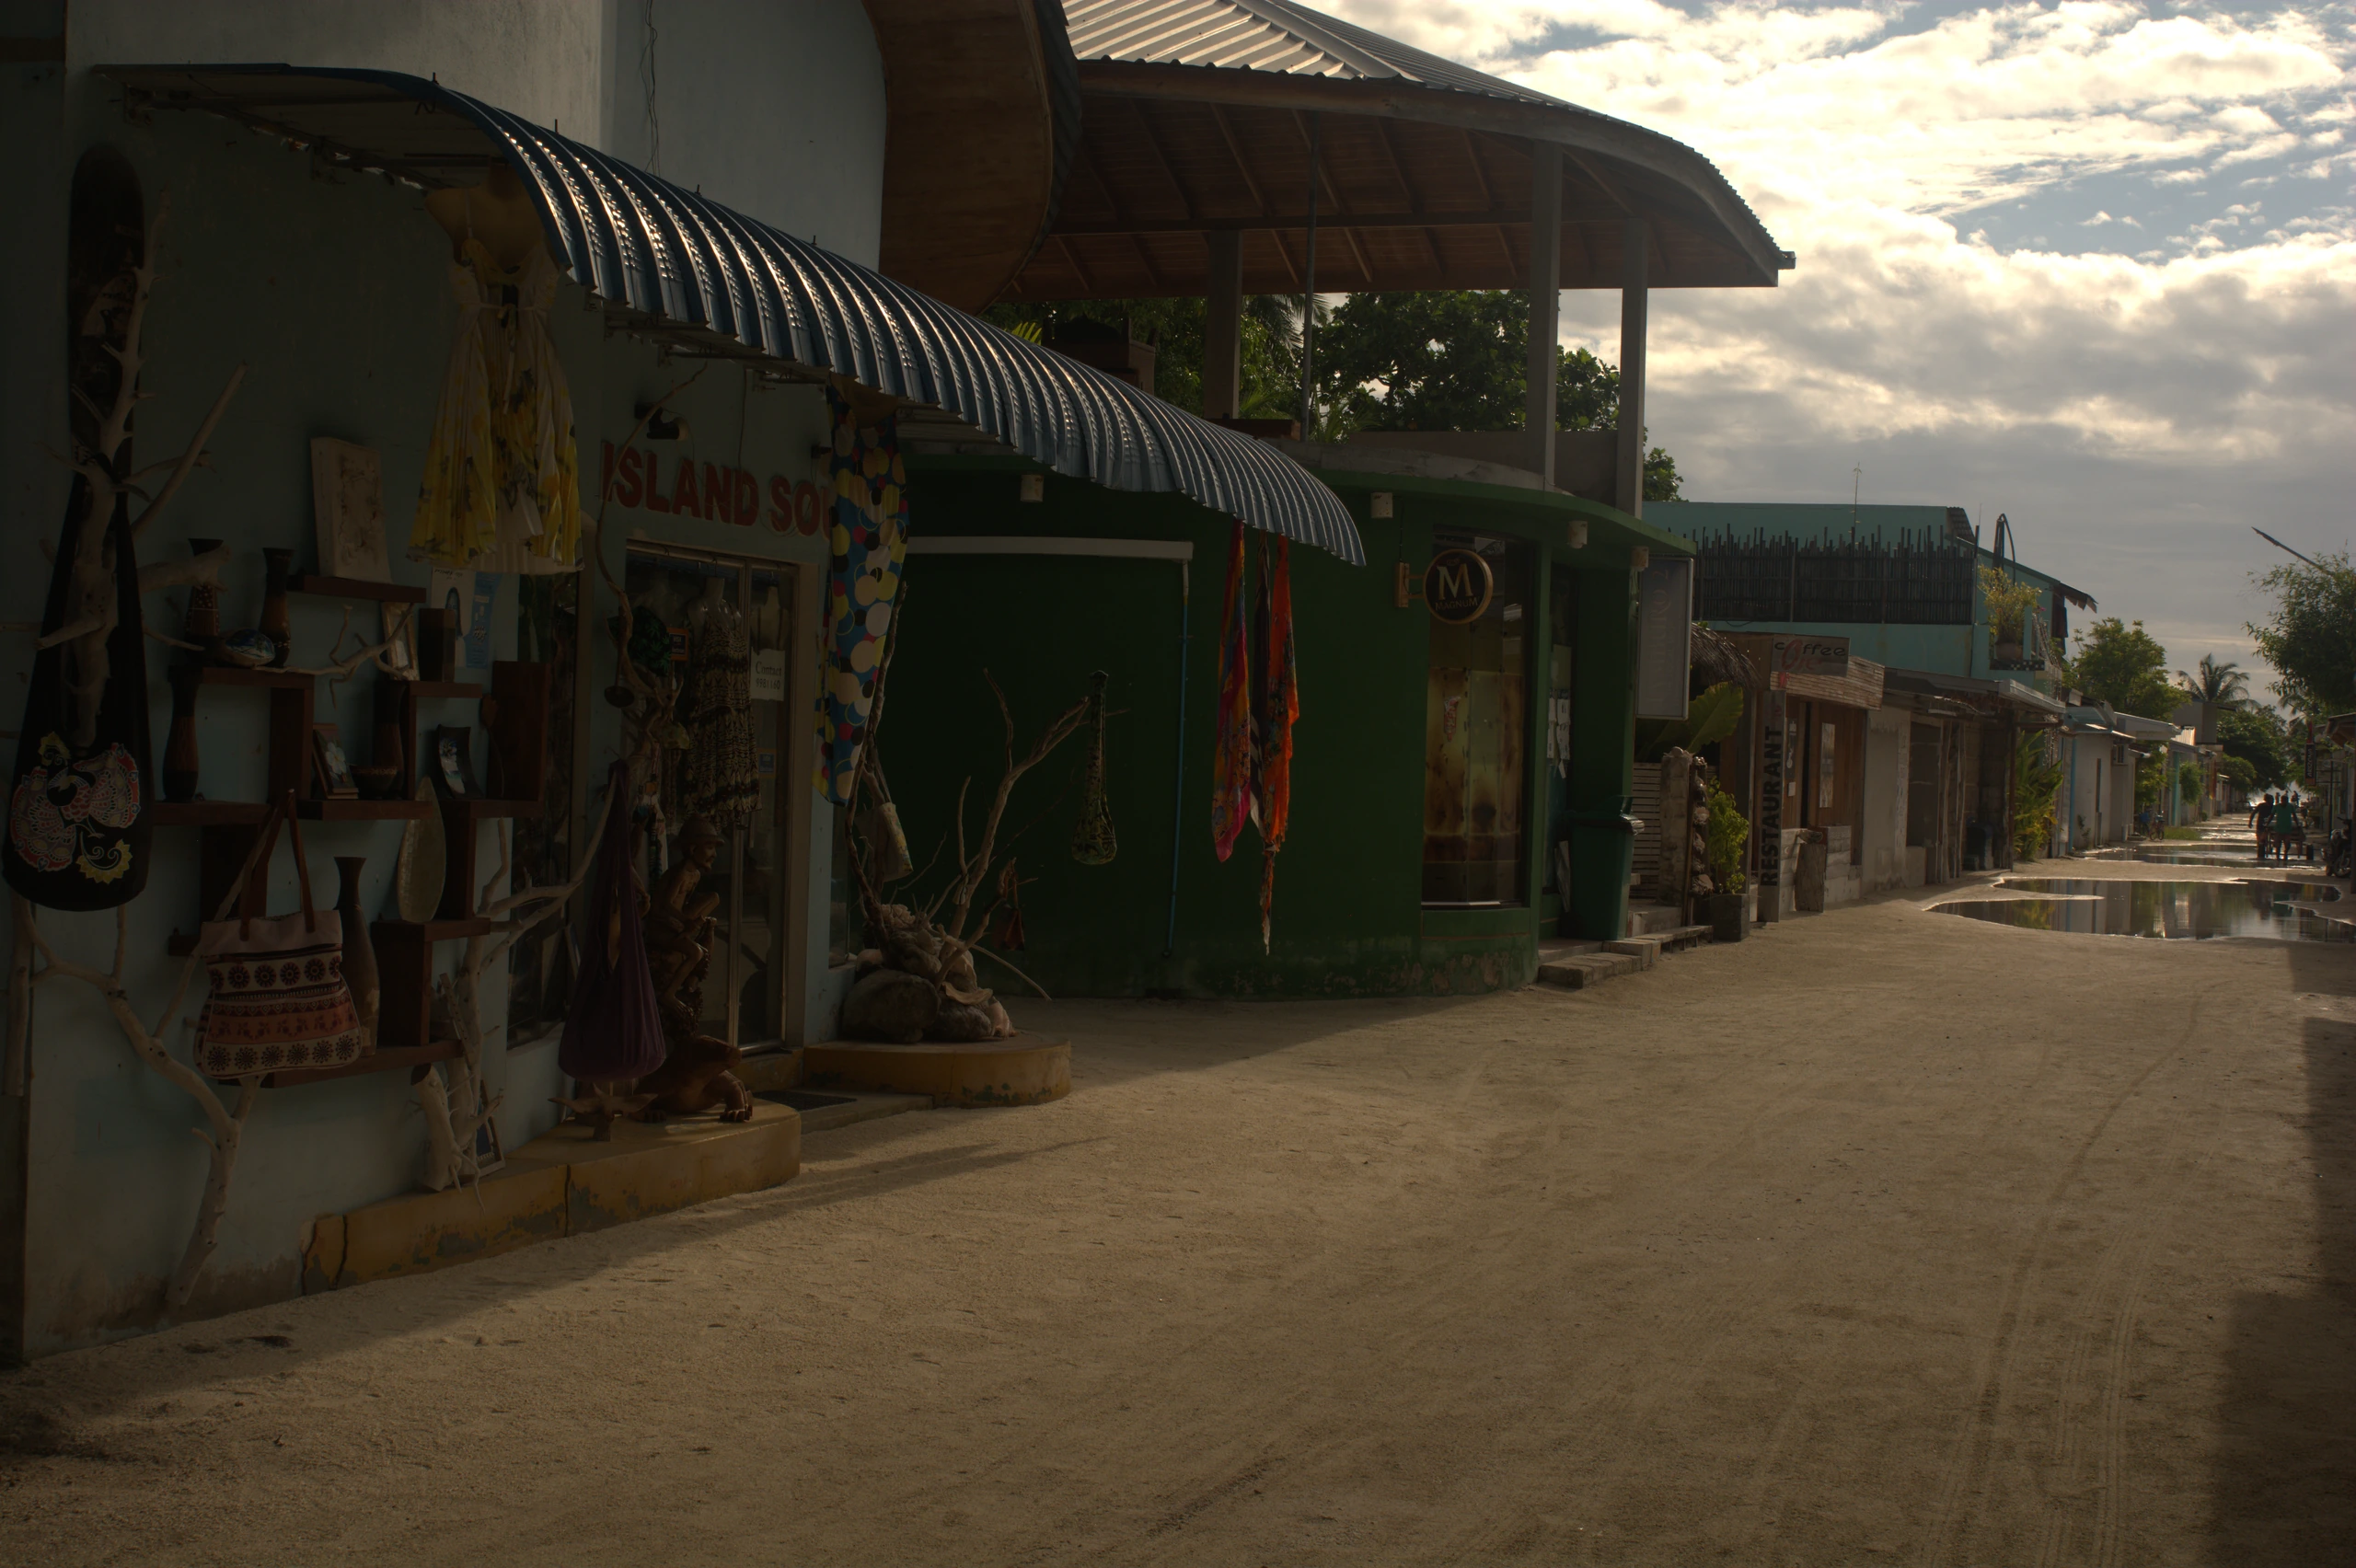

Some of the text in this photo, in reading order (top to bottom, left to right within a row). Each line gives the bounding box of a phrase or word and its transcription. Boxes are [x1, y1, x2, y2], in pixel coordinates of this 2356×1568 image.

[601, 441, 759, 526] ISLAND
[1437, 563, 1473, 600] M
[1435, 596, 1478, 611] MAGNUM
[756, 661, 782, 676] Contact
[756, 677, 780, 690] 9981160
[1760, 726, 1782, 886] RESTAURANT
